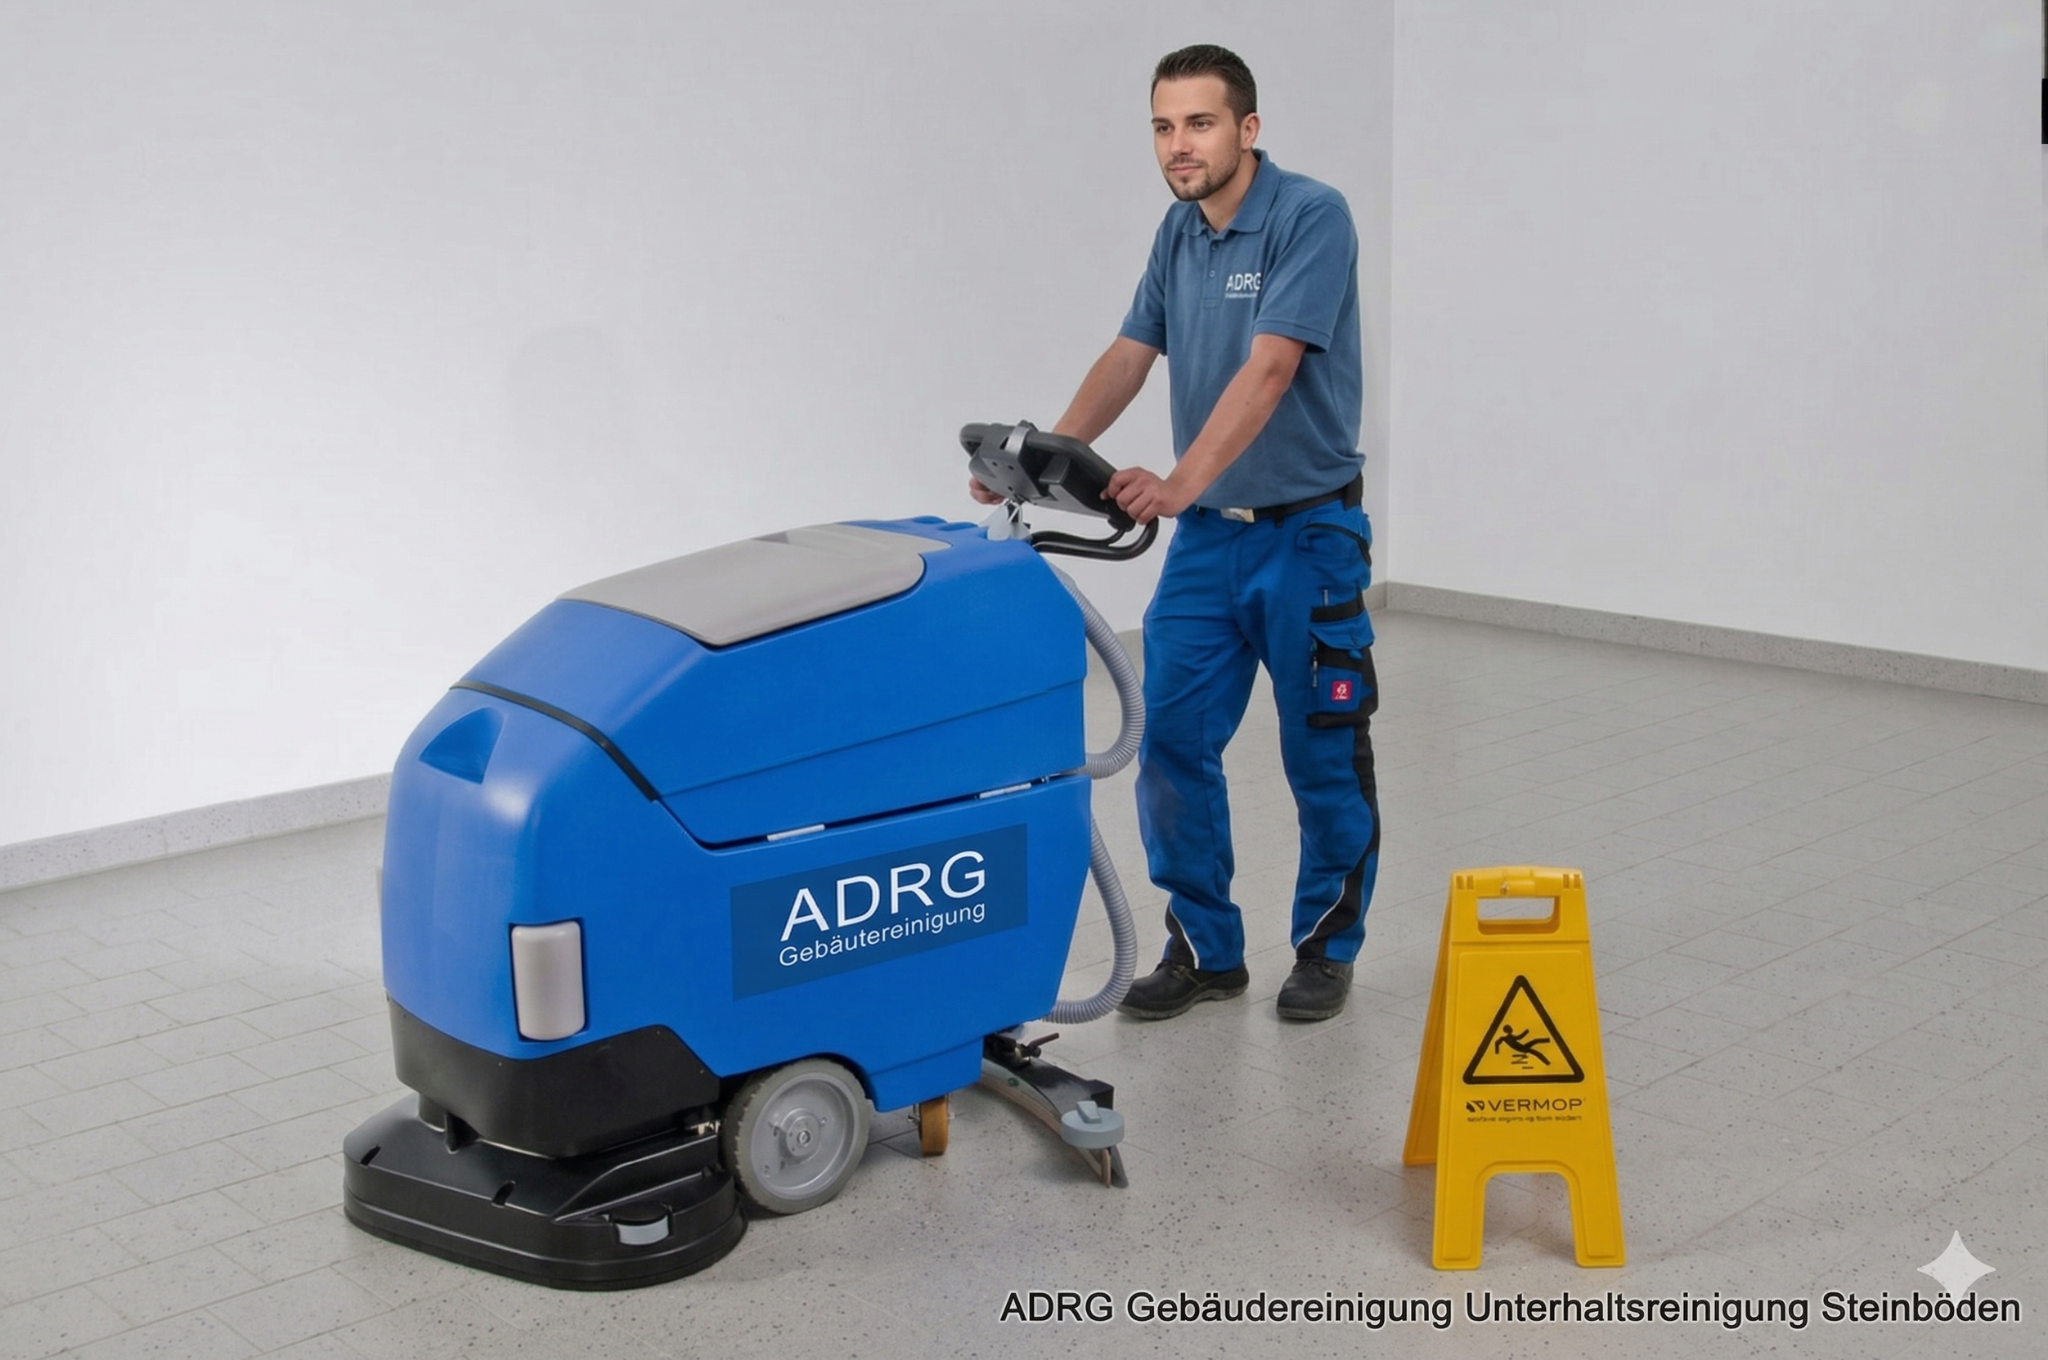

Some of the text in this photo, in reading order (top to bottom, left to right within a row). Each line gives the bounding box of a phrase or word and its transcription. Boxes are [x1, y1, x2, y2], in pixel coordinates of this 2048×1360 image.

[1225, 272, 1262, 292] ADRG
[780, 850, 986, 942] ADRG
[778, 902, 986, 967] Gebäutereinigung
[1487, 1098, 1583, 1113] VERMOP
